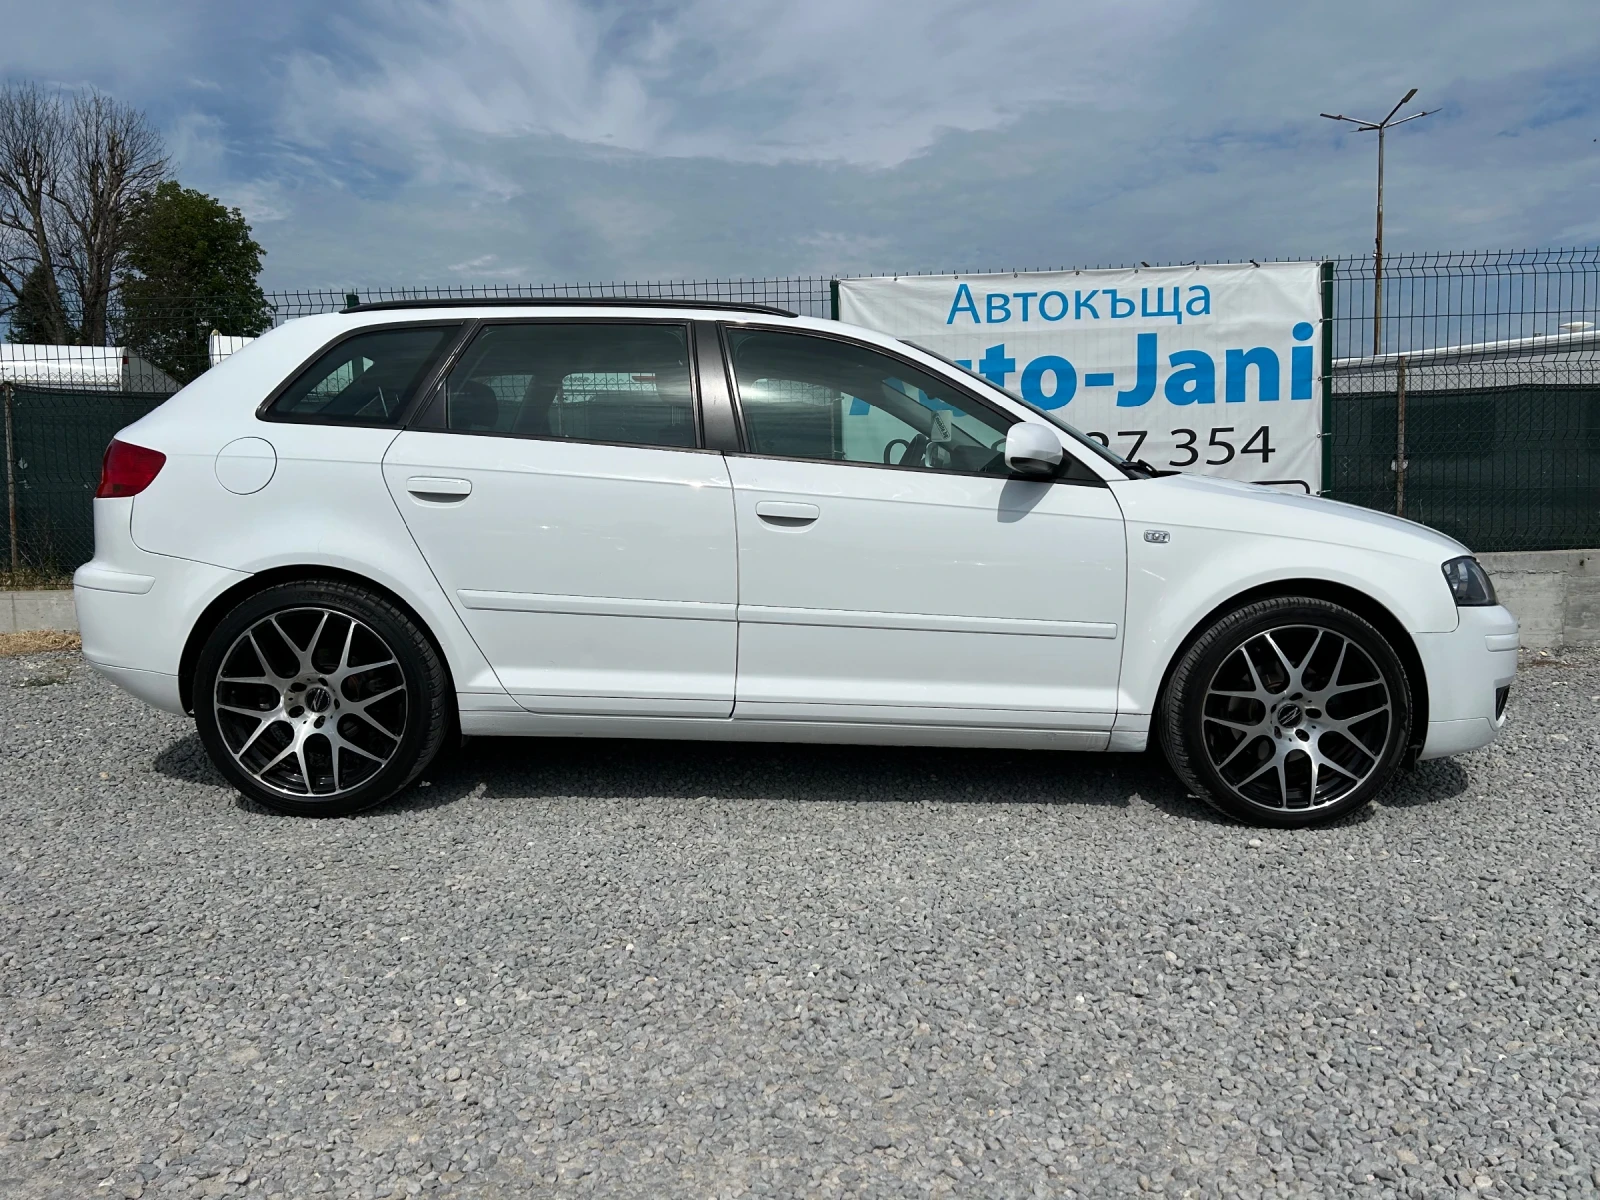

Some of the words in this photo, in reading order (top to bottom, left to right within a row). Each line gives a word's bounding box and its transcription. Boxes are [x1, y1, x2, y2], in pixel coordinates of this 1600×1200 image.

[946, 283, 1211, 324] Автокъща
[849, 322, 1313, 416] to-Jani
[1168, 426, 1276, 466] 354
